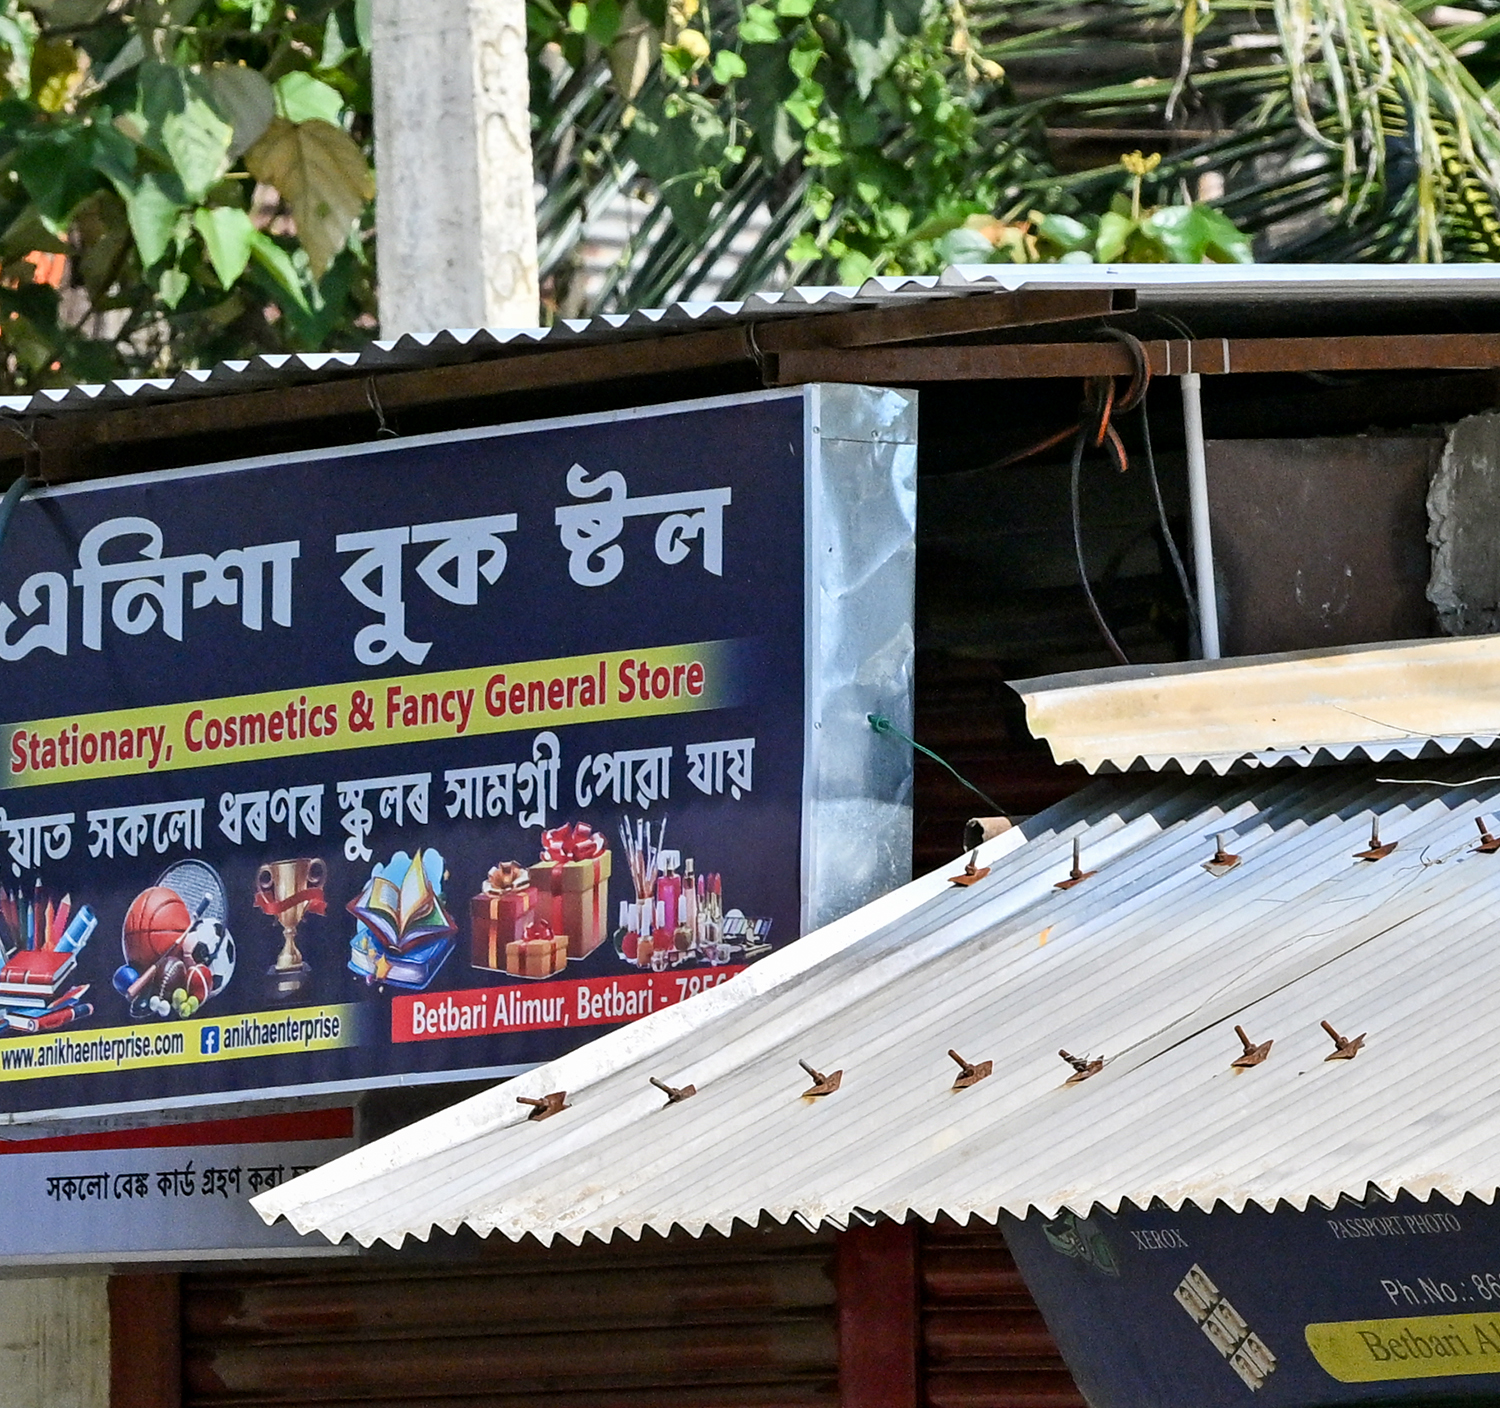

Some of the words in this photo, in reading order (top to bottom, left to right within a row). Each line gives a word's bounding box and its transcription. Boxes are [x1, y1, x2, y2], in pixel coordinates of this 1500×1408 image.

[336, 513, 517, 666] বুক
[10, 715, 174, 776] Stationary,
[184, 695, 338, 754] Cosmetics
[348, 690, 376, 733] &
[386, 681, 474, 733] Fancy
[483, 660, 609, 721] General
[617, 653, 706, 701] Store
[87, 797, 206, 861] সকলো
[218, 783, 324, 846] ধৰণৰ
[686, 737, 755, 801] যায়
[411, 992, 487, 1036] Betbari
[492, 987, 570, 1029] Alimur,
[577, 979, 654, 1021] Betbari
[1, 1030, 184, 1073] www.anikhaenterprise.com
[223, 1013, 340, 1051] anikhaenterprise
[47, 1171, 110, 1201] সকলো
[1131, 1229, 1189, 1250] XEROX
[1327, 1216, 1404, 1239] PASSPORT
[1406, 1213, 1462, 1235] PHOTO
[1357, 1324, 1473, 1363] Betbari
